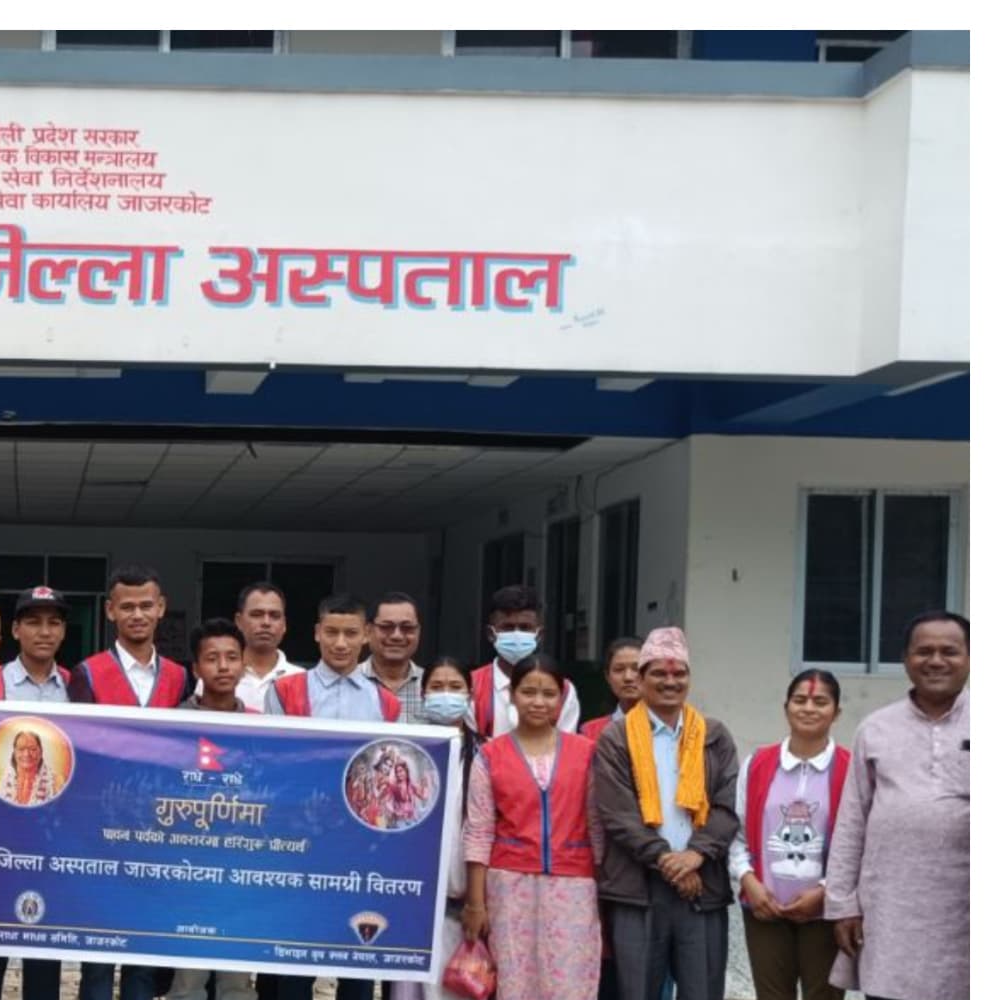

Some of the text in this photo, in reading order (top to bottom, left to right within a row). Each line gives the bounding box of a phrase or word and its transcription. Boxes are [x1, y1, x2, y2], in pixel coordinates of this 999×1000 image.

[32, 122, 77, 145] प्रदेश
[83, 129, 139, 145] सरकार
[25, 149, 80, 167] विकास
[84, 150, 158, 169] मन्त्रालय
[2, 168, 42, 187] सेवा
[51, 167, 167, 190] निर्देशनालय
[32, 190, 111, 212] कार्यालय
[117, 191, 213, 215] जाजरकोट
[200, 245, 577, 314] अस्पताल
[49, 855, 119, 877] अस्पताल
[124, 859, 224, 884] जाजरकोटमा
[229, 867, 304, 888] आवश्यक
[308, 870, 361, 893] सामग्री
[367, 872, 423, 896] वितरण
